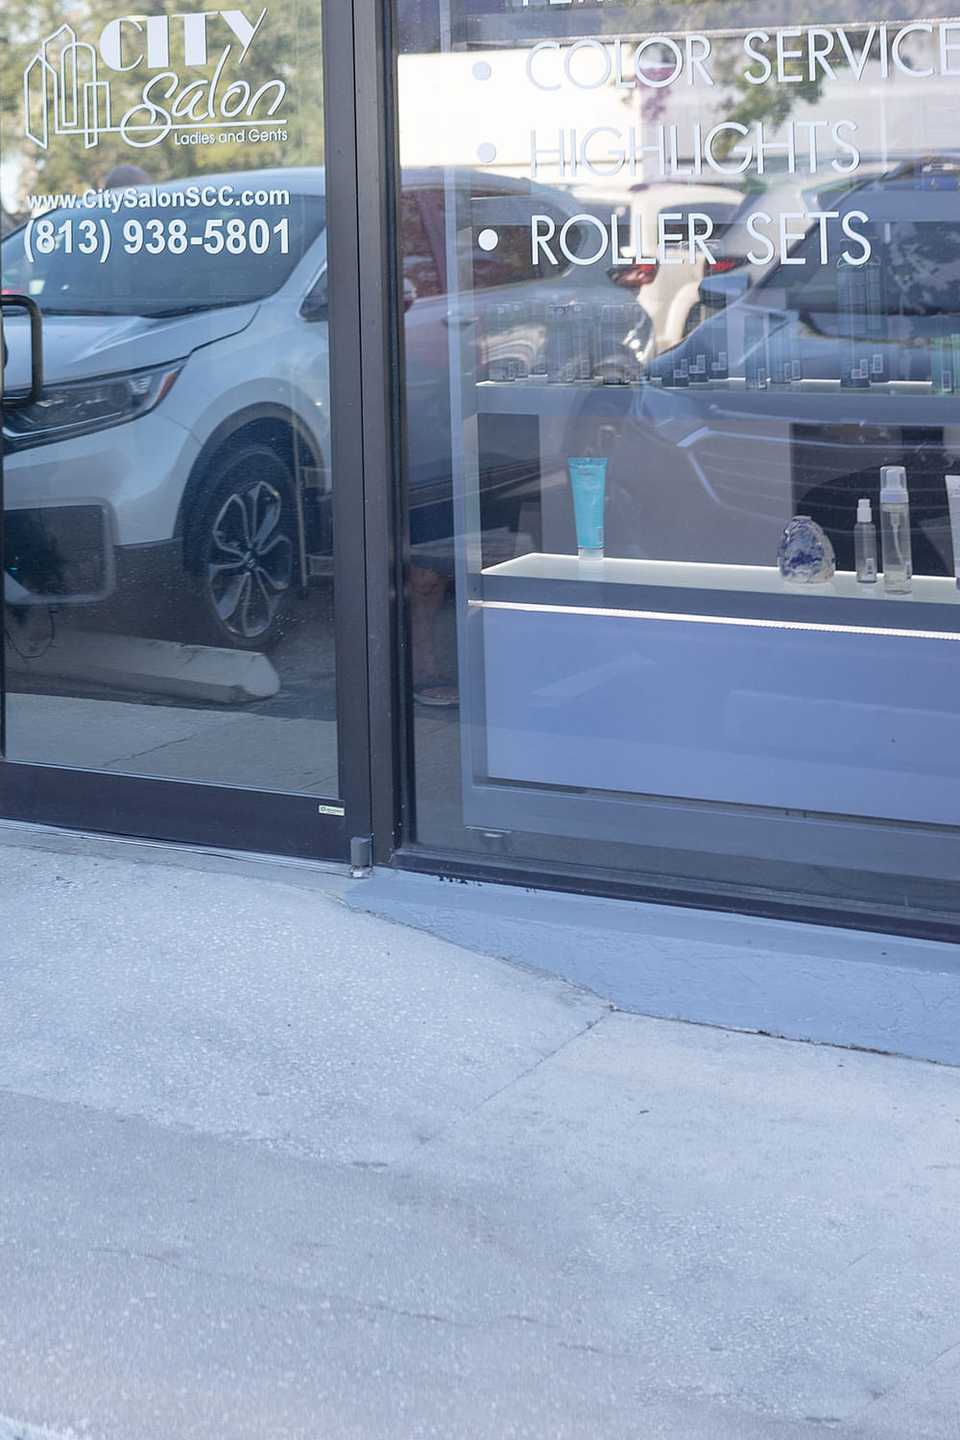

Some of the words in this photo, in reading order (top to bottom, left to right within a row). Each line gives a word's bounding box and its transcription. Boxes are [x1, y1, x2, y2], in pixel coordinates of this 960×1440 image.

[100, 8, 268, 72] CITY
[527, 35, 715, 91] COLOR
[120, 44, 287, 148] Salon
[174, 131, 216, 145] Ladies
[219, 129, 246, 144] and
[248, 128, 288, 143] Gents
[530, 120, 861, 178] HIGHLIGHTS
[26, 186, 291, 213] www.CitySalonSCC.com
[23, 218, 112, 263] (813)
[123, 218, 290, 255] 938-5801
[531, 213, 716, 266] ROLLER
[746, 210, 872, 266] SETS
